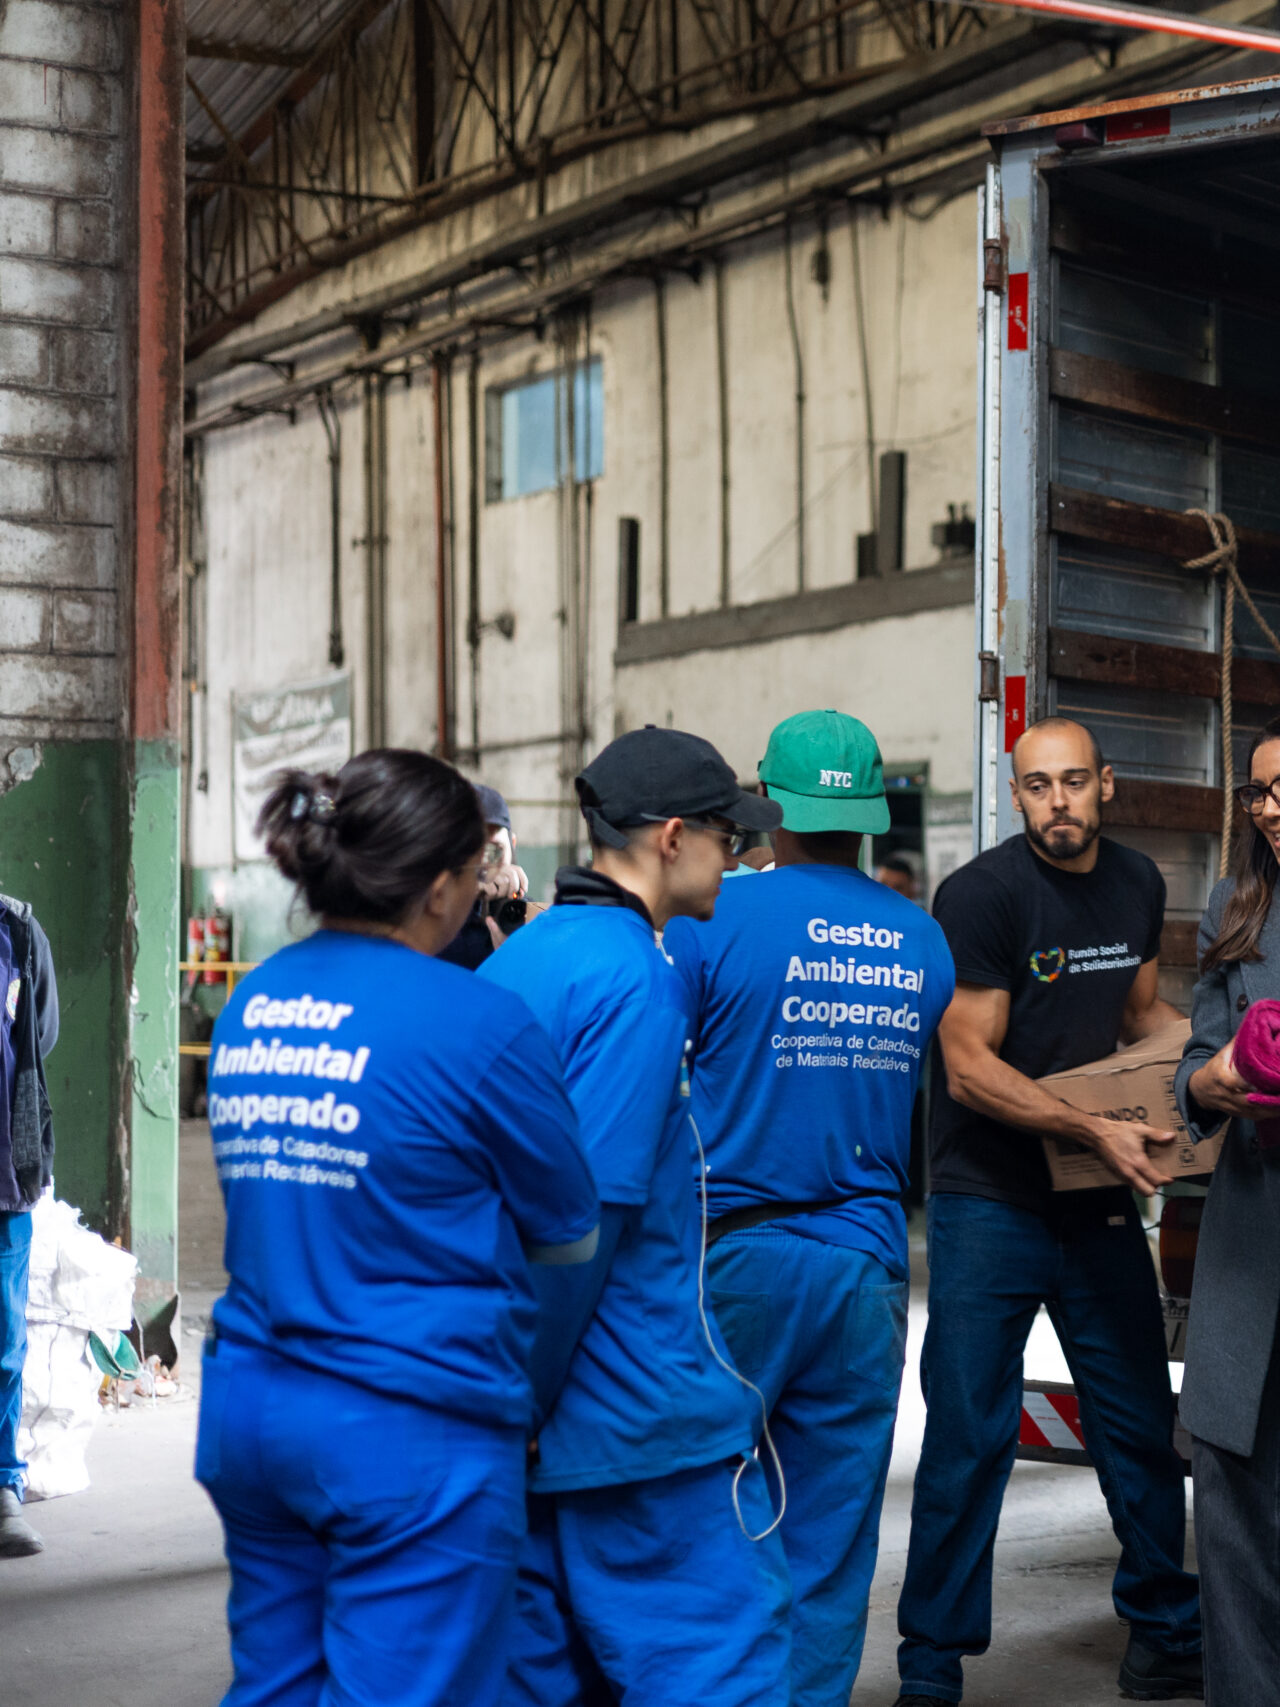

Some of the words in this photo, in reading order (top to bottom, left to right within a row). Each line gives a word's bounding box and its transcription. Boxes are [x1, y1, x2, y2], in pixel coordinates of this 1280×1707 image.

[819, 769, 852, 788] NYC
[807, 918, 904, 950] Gestor
[1068, 946, 1098, 960] Fundo
[1099, 943, 1128, 956] Social
[1069, 962, 1081, 974] de
[1081, 954, 1142, 971] Solidariedad
[785, 955, 924, 994] Ambiental
[242, 993, 354, 1030] Gestor
[782, 996, 920, 1032] Cooperado
[213, 1038, 370, 1083] Ambiental
[847, 1034, 864, 1049] de
[867, 1035, 920, 1059] Catadoes
[776, 1053, 793, 1068] de
[852, 1054, 910, 1073] Recicláve
[209, 1092, 360, 1133] Cooperado
[259, 1135, 279, 1155] de
[263, 1159, 357, 1190] Recláveis
